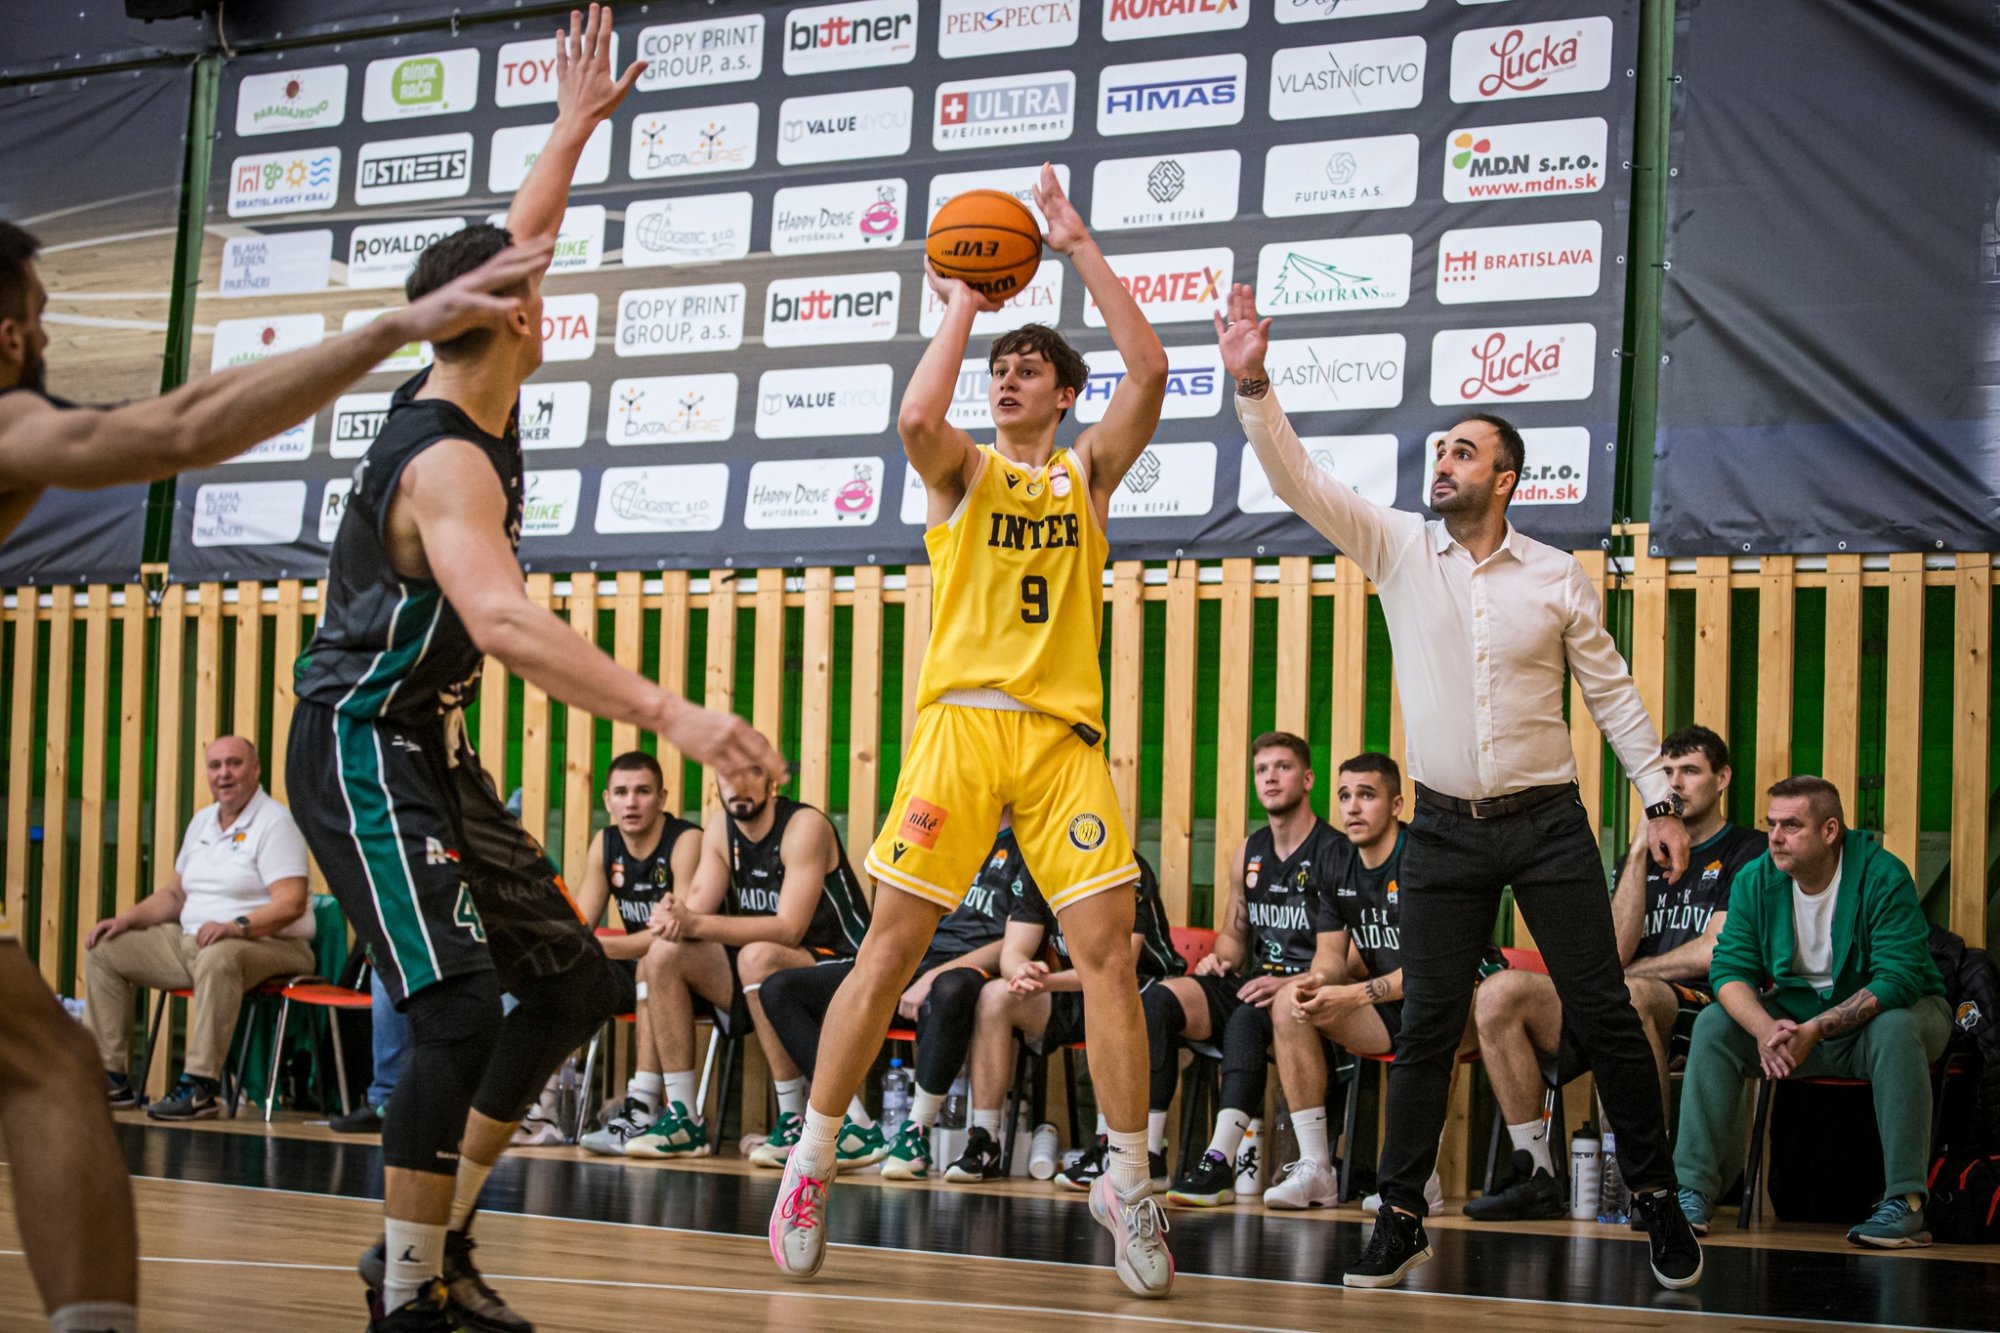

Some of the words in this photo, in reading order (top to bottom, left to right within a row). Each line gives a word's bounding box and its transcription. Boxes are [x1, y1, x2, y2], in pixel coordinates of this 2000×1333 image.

[947, 3, 1072, 34] PERSPECTA
[644, 32, 696, 56] COPY
[702, 25, 759, 50] PRINT
[643, 55, 714, 80] GROUP,
[721, 54, 751, 71] a.s.
[1479, 29, 1578, 96] Lucka
[974, 86, 1062, 120] ULTRA
[1106, 76, 1237, 114] HTMAS
[1538, 155, 1599, 172] s.r.o.
[1468, 173, 1597, 196] www.mdn.sk
[1123, 213, 1164, 225] MARTIN
[354, 232, 449, 262] ROYALDO
[1484, 249, 1593, 270] BRATISLAVA
[625, 298, 677, 321] COPY
[683, 293, 740, 316] PRINT
[1285, 286, 1379, 304] LESOTRANS
[541, 315, 589, 341] OTA
[622, 322, 694, 346] GROUP,
[701, 323, 731, 340] a.s.
[1460, 332, 1561, 399] Lucka
[1086, 367, 1215, 401] HAS
[520, 428, 550, 441] OKER
[1511, 484, 1579, 500] mdn.sk
[1113, 504, 1138, 514] RTIN
[988, 512, 1079, 550] INTER
[1021, 575, 1049, 623] 9
